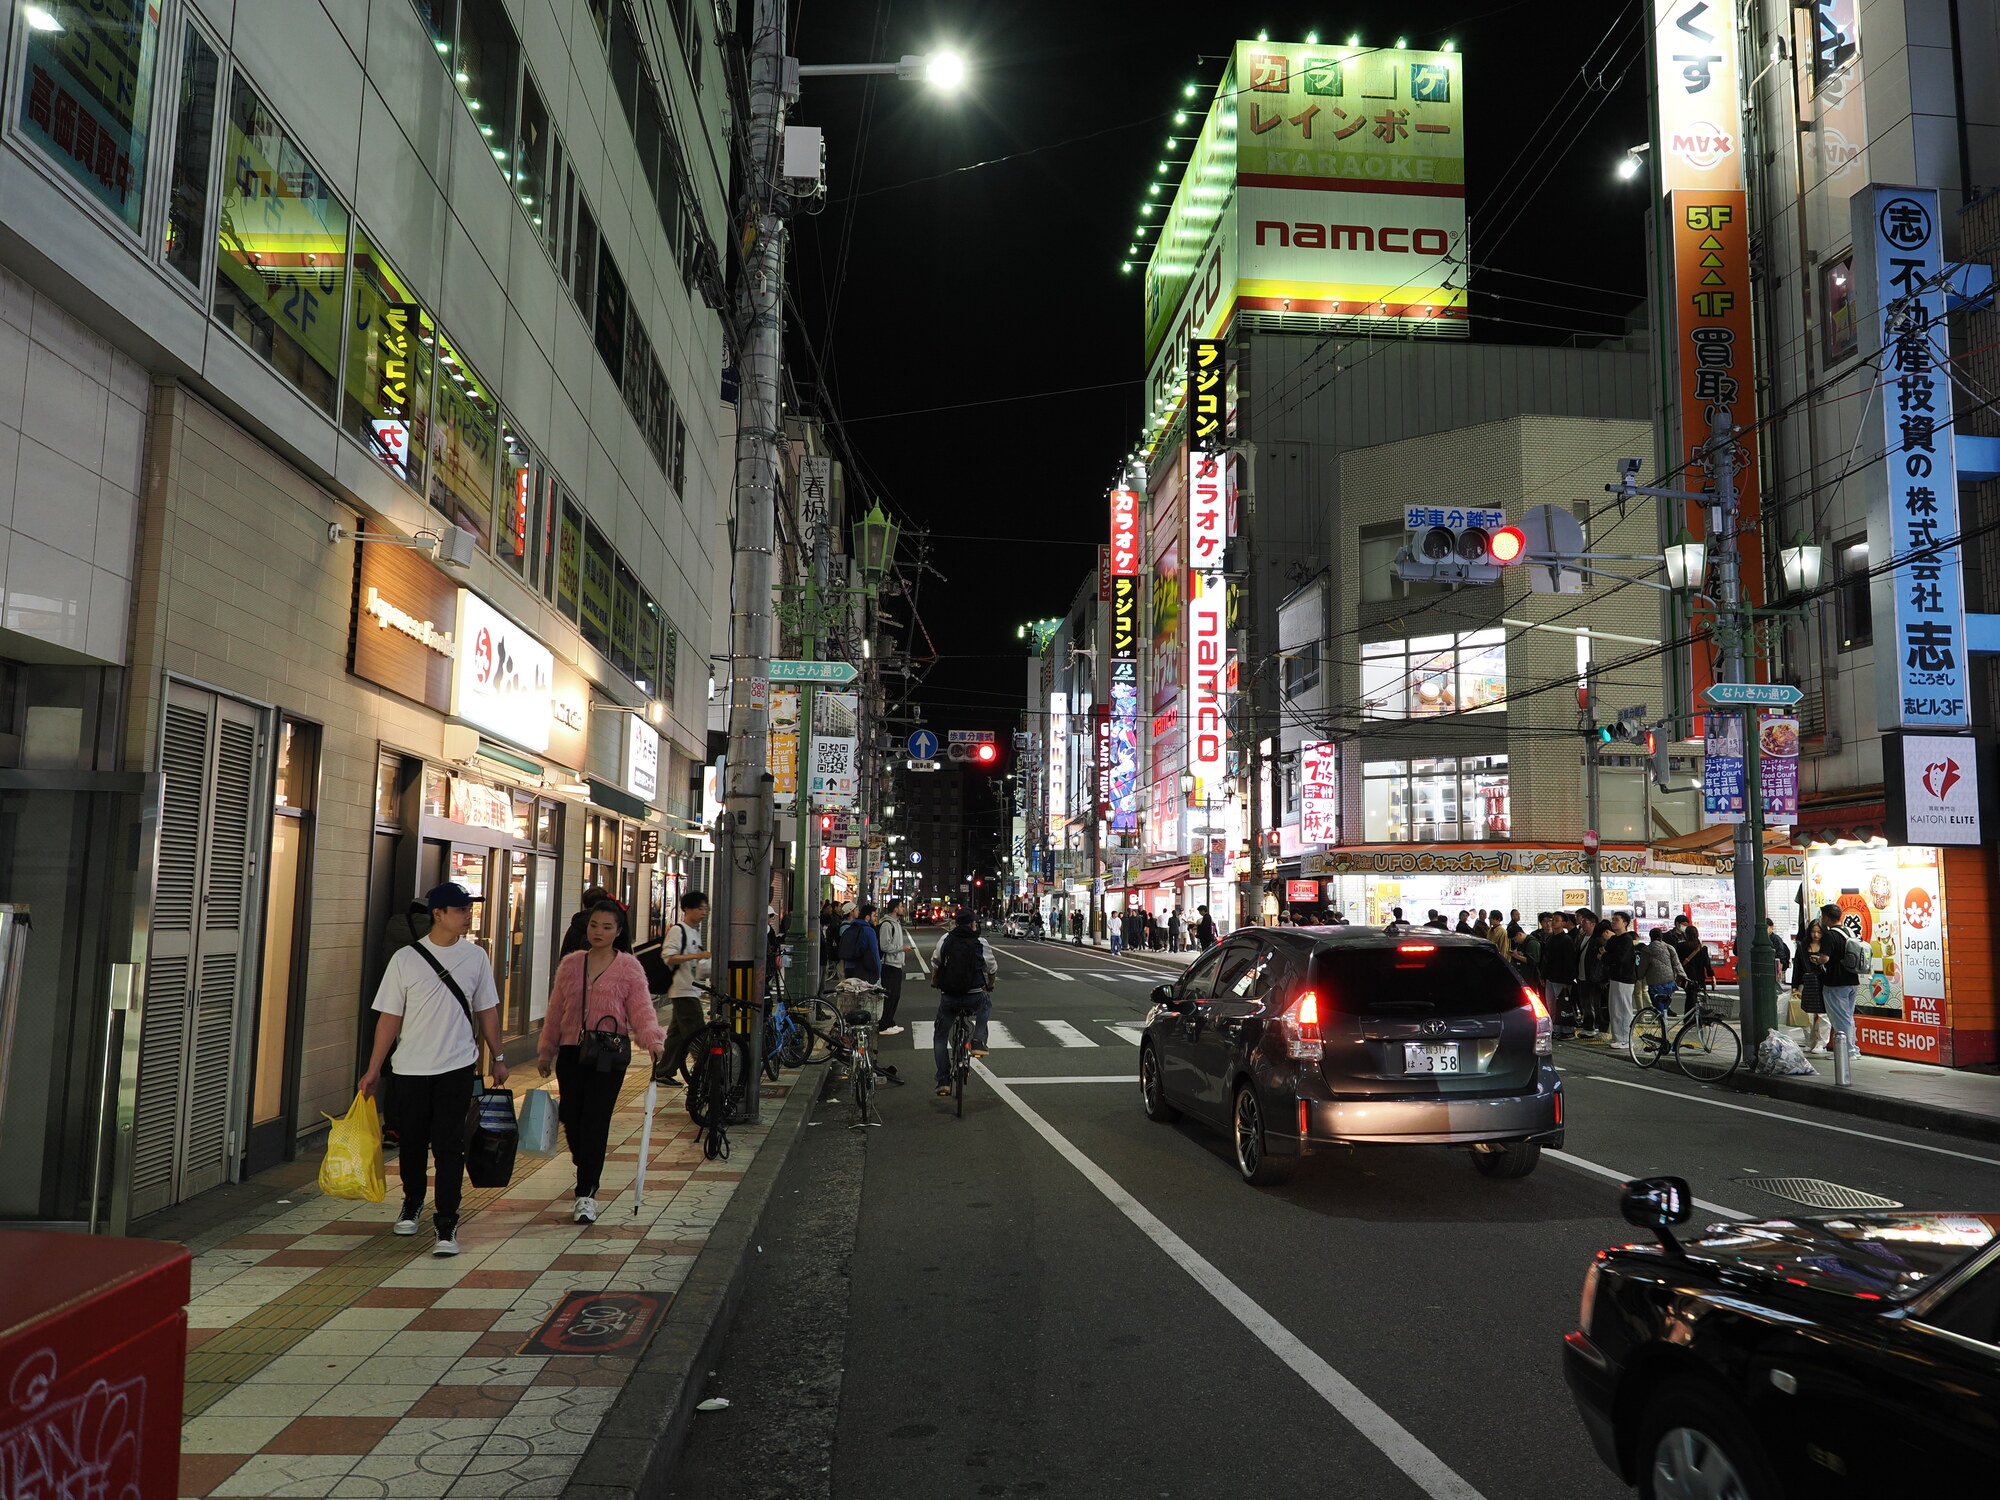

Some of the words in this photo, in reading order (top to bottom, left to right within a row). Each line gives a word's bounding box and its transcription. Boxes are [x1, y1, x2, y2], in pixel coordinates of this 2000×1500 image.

[1249, 101, 1452, 143] レインボー
[1266, 149, 1435, 181] KARAOKE
[1687, 206, 1732, 231] 5F
[1255, 220, 1450, 256] namco
[1692, 292, 1734, 317] 1F
[1196, 345, 1219, 438] ラジコン
[1196, 459, 1219, 557] カラオケ
[1407, 508, 1504, 528] 歩車分離式
[1115, 492, 1134, 568] カラオケ
[1115, 578, 1133, 651] ラジコン
[1905, 620, 1956, 671] 志
[770, 664, 844, 677] なんさん通り
[1198, 611, 1218, 762] namco
[1909, 673, 1955, 686] こころざし
[1722, 687, 1790, 700] なんさん通り
[1904, 698, 1964, 716] 志ビル3F
[949, 731, 994, 742] 歩車分離式
[1705, 762, 1743, 772] フードホール
[1722, 770, 1742, 778] Court
[1761, 763, 1798, 772] フードホール
[1776, 771, 1797, 779] Court
[1705, 777, 1738, 788] 푸드코트
[1910, 814, 1947, 824] KAITORI
[1950, 815, 1975, 824] ELITE
[1839, 896, 1867, 913] MIYAGE
[1904, 937, 1940, 953] Japan.
[1904, 954, 1941, 968] Tax-free
[1917, 968, 1942, 983] Shop
[1912, 997, 1937, 1011] TAX
[1910, 1011, 1941, 1025] FREE
[1861, 1028, 1895, 1047] FREE
[1897, 1032, 1937, 1051] SHOP
